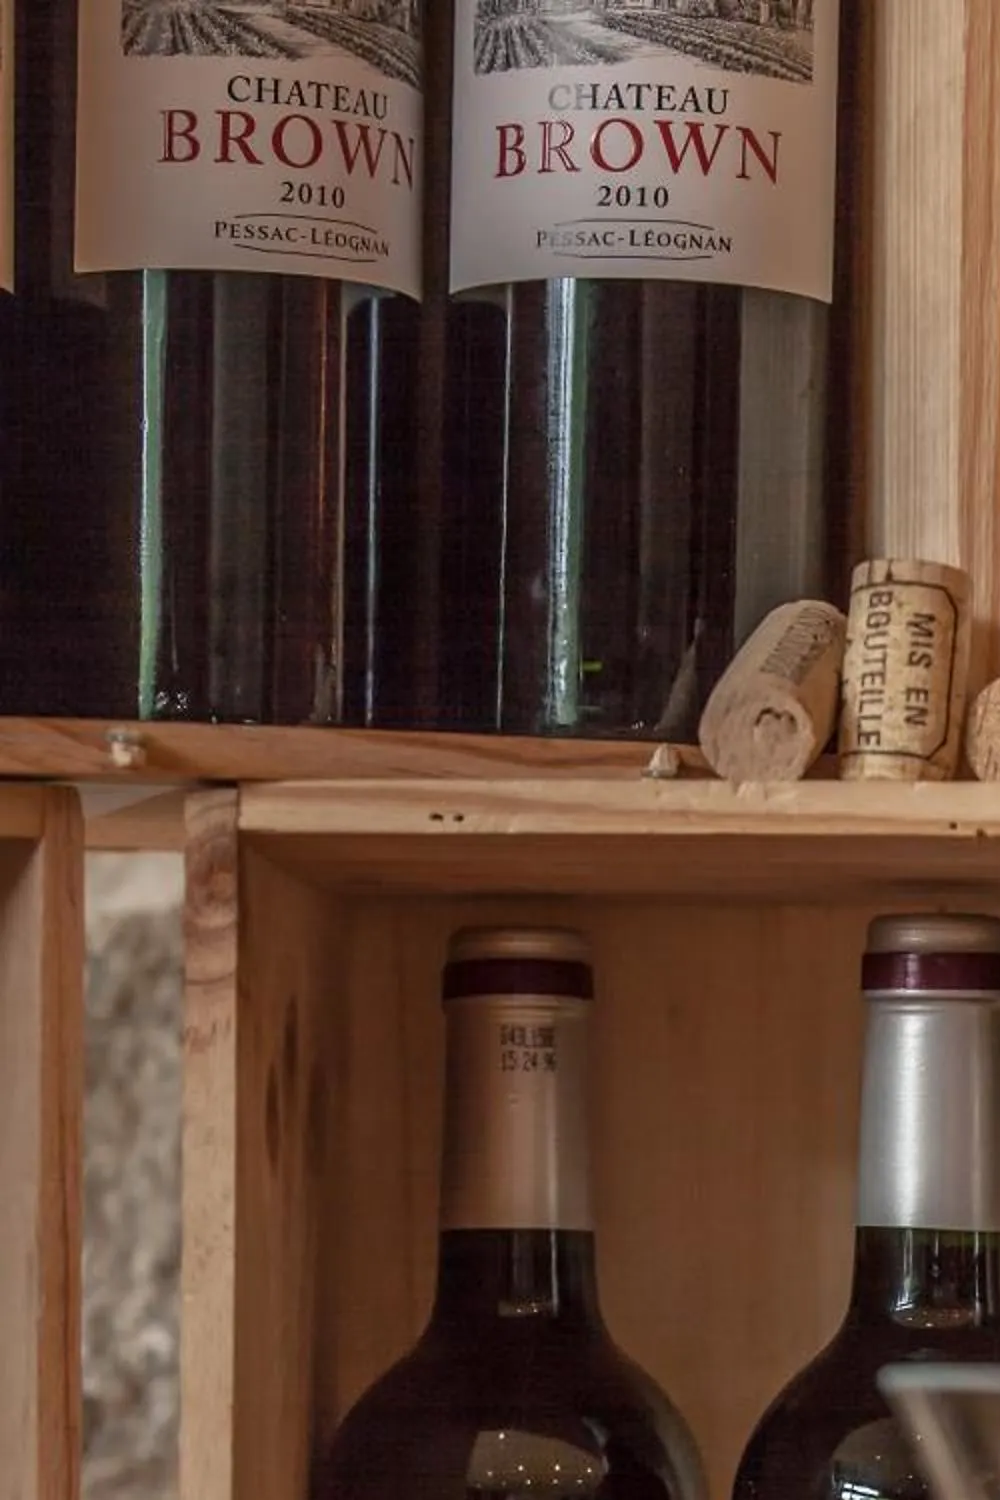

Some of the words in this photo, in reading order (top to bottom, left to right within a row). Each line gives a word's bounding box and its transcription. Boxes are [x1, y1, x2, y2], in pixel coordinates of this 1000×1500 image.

[227, 75, 388, 120] CHATEAU
[548, 83, 730, 115] CHATEAU
[157, 109, 415, 192] BROWN
[494, 118, 782, 185] BROWN
[280, 181, 346, 209] 2010
[597, 185, 669, 208] 2010
[214, 220, 390, 257] PESSAC-LÉOGNAN
[536, 228, 734, 252] PESSAC-LÉOGNAN
[906, 611, 936, 670] MIS
[903, 686, 929, 727] EN
